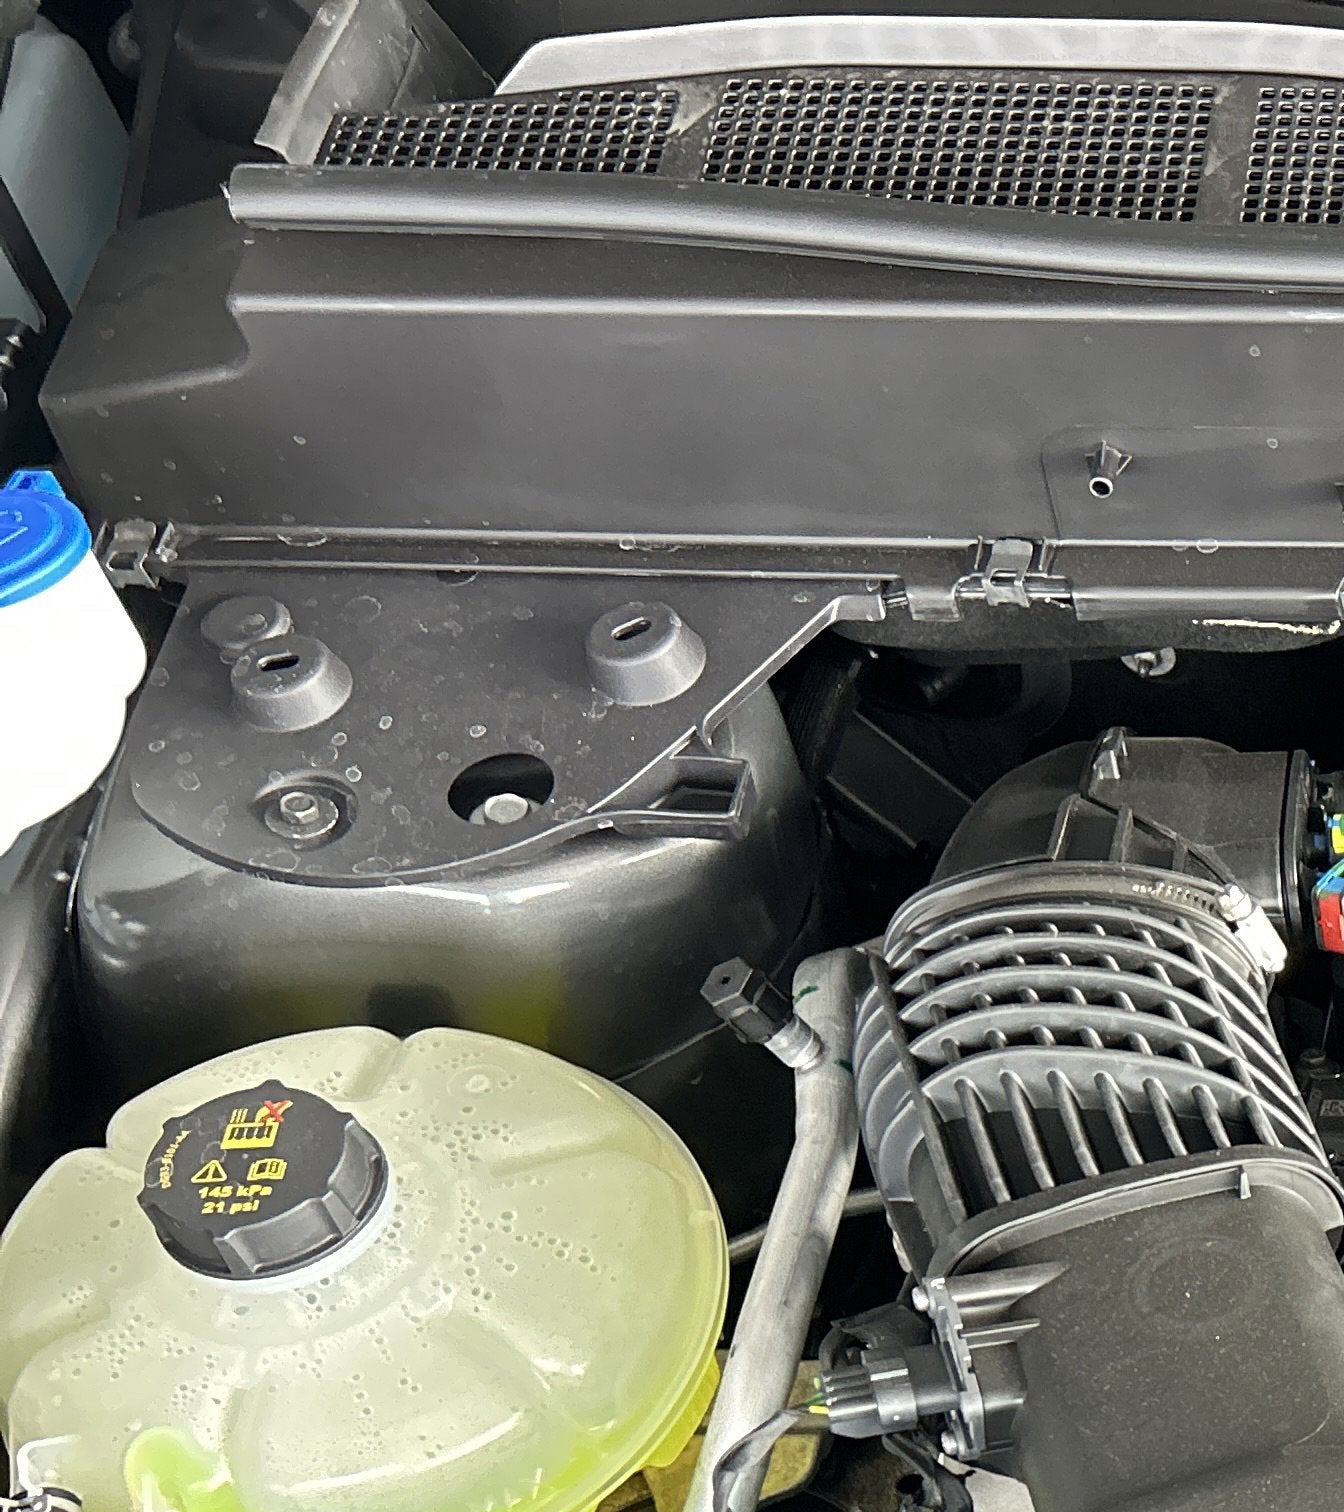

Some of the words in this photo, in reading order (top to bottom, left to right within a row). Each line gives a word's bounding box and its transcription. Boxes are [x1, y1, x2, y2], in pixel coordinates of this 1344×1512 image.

[198, 1187, 233, 1198] 145
[237, 1185, 272, 1197] kPa
[201, 1202, 223, 1214] 21
[230, 1200, 259, 1215] psi
